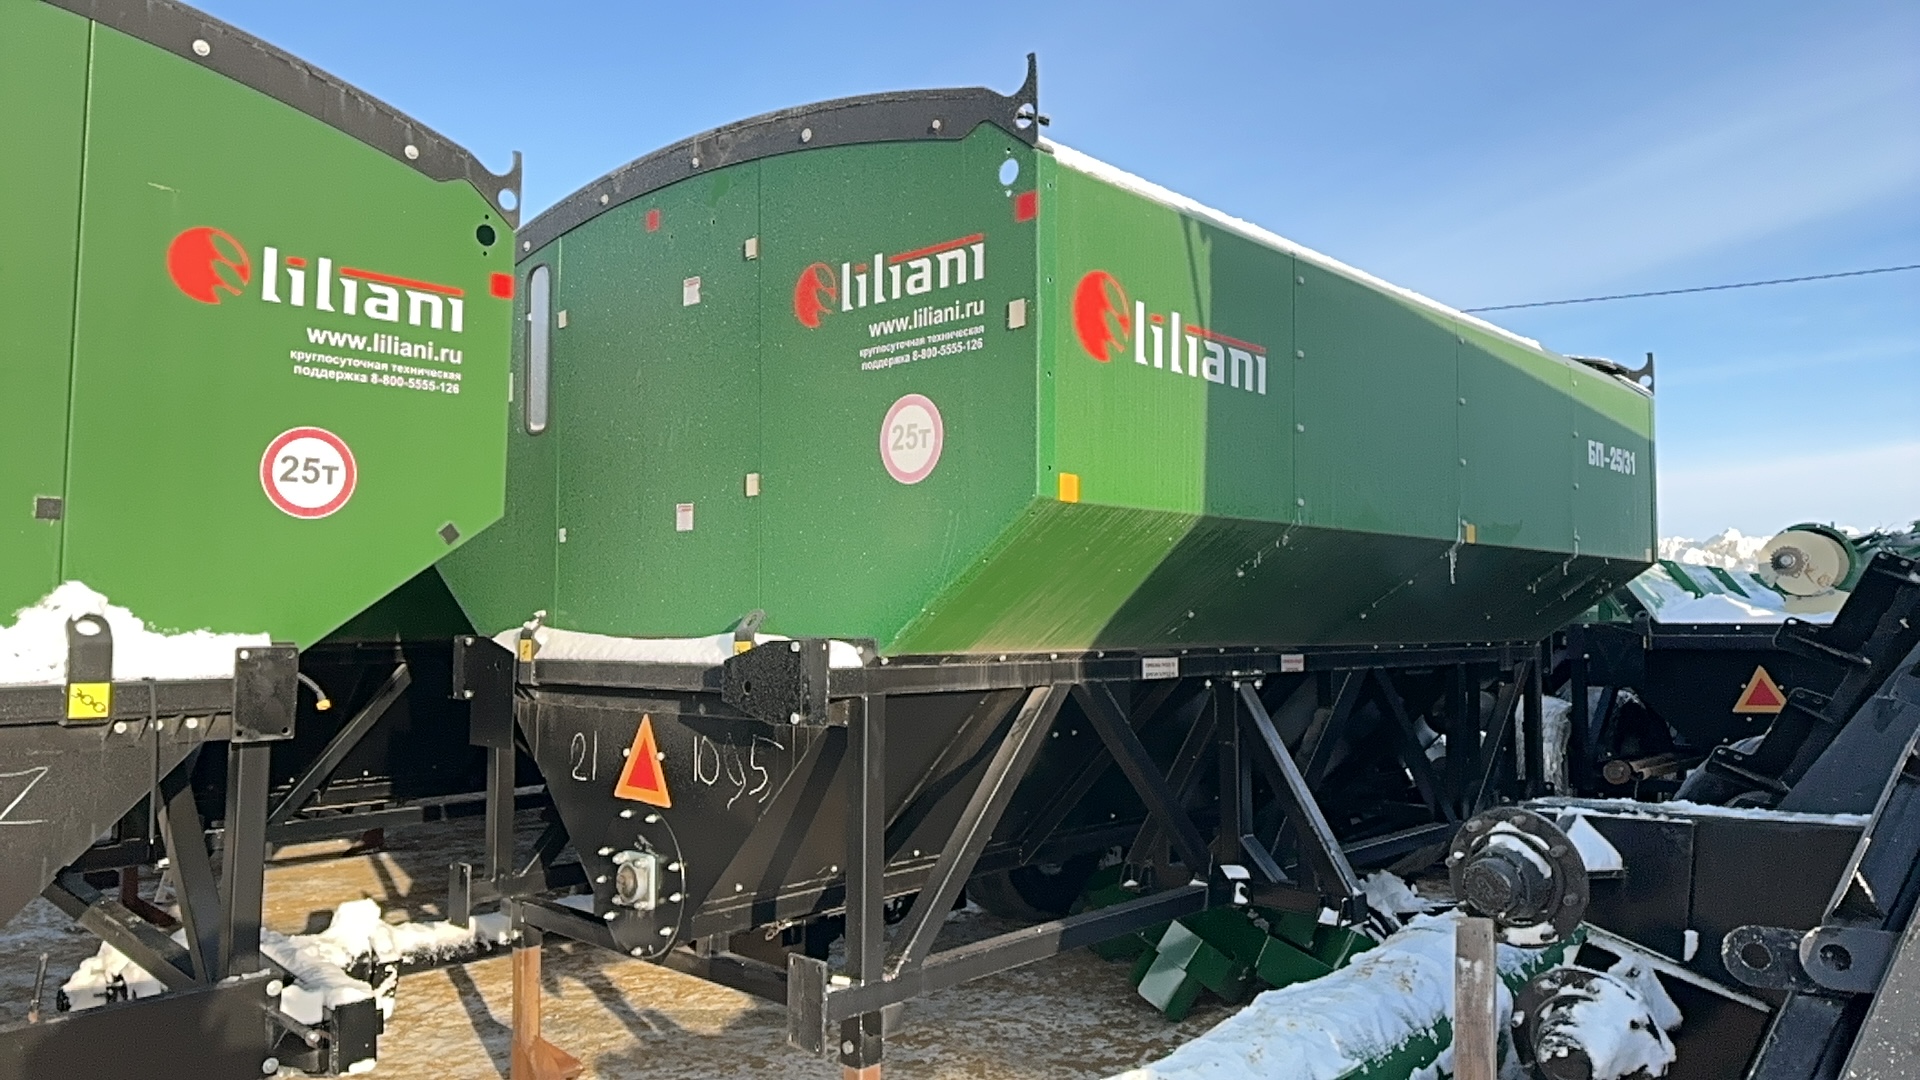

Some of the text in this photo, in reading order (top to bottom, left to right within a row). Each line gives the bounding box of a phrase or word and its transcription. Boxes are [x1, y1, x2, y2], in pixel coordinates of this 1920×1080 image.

[261, 246, 465, 332] liliani
[841, 232, 985, 312] liliani
[869, 300, 984, 338] www.liliani.ru
[306, 327, 464, 365] www.liliani.ru
[859, 325, 984, 358] круглосуточная техническая
[861, 338, 983, 371] поддержка 8-800-5555-126
[1135, 300, 1267, 395] liliani
[290, 350, 462, 381] круглосуточная техническая
[293, 365, 460, 394] поддержка 8-800-5555-126
[570, 731, 598, 781] 21
